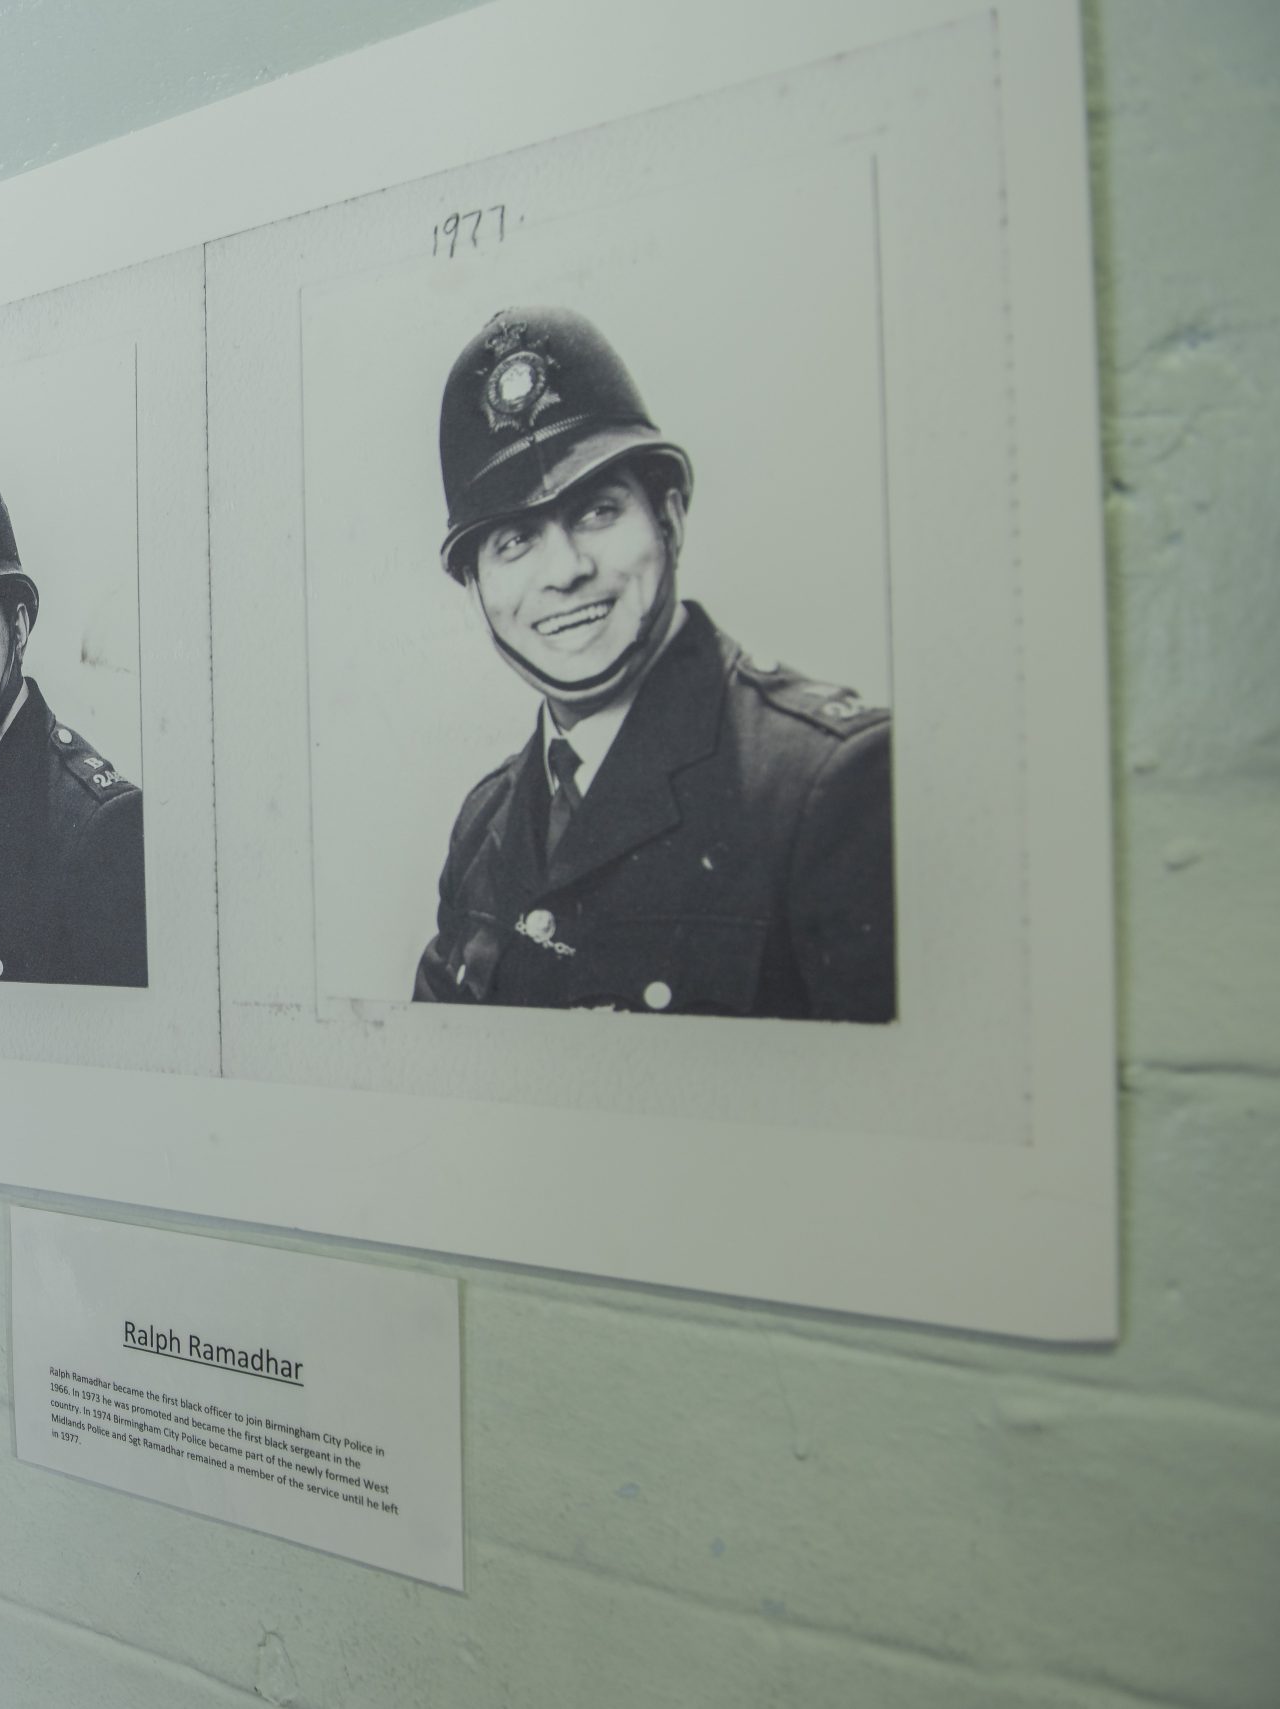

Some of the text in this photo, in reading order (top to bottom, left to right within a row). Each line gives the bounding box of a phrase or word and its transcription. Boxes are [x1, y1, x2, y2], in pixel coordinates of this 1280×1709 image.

[124, 1320, 303, 1380] Ralph Ramadhar
[49, 1367, 385, 1456] Ralph Ramadhar became the first black officer to join Birmingham City Police in
[49, 1402, 390, 1493] country. In 1974 Birmingham City Police became part of the newly formed West
[50, 1382, 361, 1468] 1966. In 1973 he was promoted and became the first black sergeant in the
[50, 1428, 83, 1445] in 1977.
[51, 1414, 86, 1431] Midlands
[86, 1423, 111, 1438] Police
[111, 1432, 127, 1442] and
[128, 1434, 142, 1447] Sgt
[142, 1438, 185, 1457] Ramadhar
[186, 1453, 227, 1468] remained
[236, 1466, 275, 1481] member
[276, 1475, 287, 1484] of
[288, 1477, 305, 1489] the
[306, 1484, 340, 1498] service
[341, 1494, 364, 1504] until
[366, 1497, 380, 1508] he
[381, 1501, 399, 1514] left
